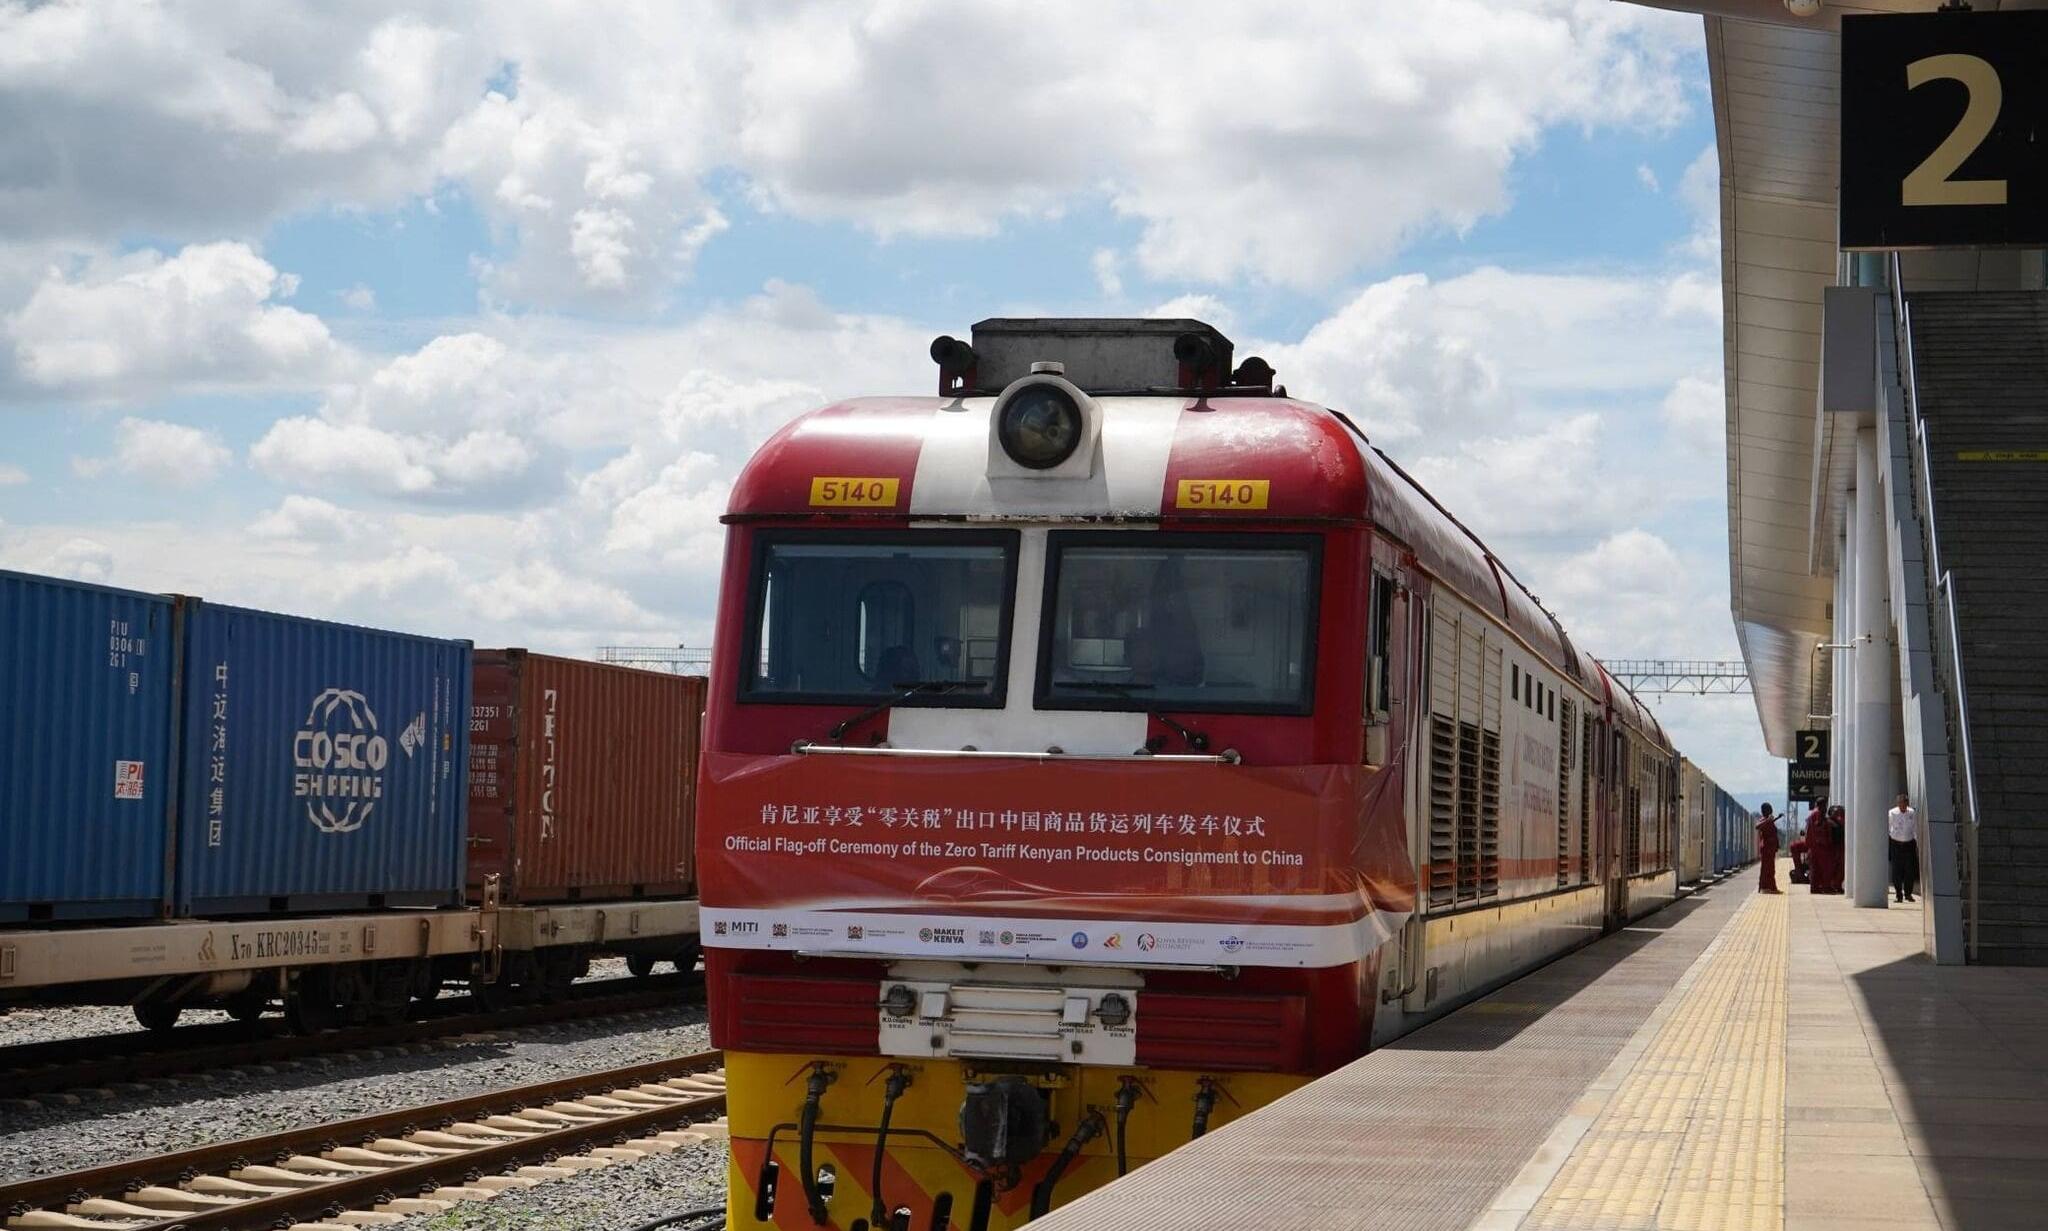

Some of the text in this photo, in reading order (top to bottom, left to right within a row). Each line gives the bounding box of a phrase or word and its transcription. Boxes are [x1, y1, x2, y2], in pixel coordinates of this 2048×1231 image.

[1902, 53, 2007, 206] 2
[822, 482, 884, 501] 5140
[1190, 484, 1253, 504] 5140
[294, 731, 387, 770] COSCO
[1804, 736, 1820, 758] 2
[1792, 769, 1830, 778] NAIROB
[295, 774, 381, 797] SHPPING
[760, 803, 1266, 837] 肯尼亚享受“零关税”出口中国商品货运列车发车仪式
[725, 836, 1303, 867] Official Flag-off Ceremony of the Zero Tariff Kenyan Products Consignment to China
[731, 921, 758, 932] MITI
[934, 928, 957, 936] MAKE
[256, 930, 318, 958] KRC20345
[934, 935, 964, 944] KENYA
